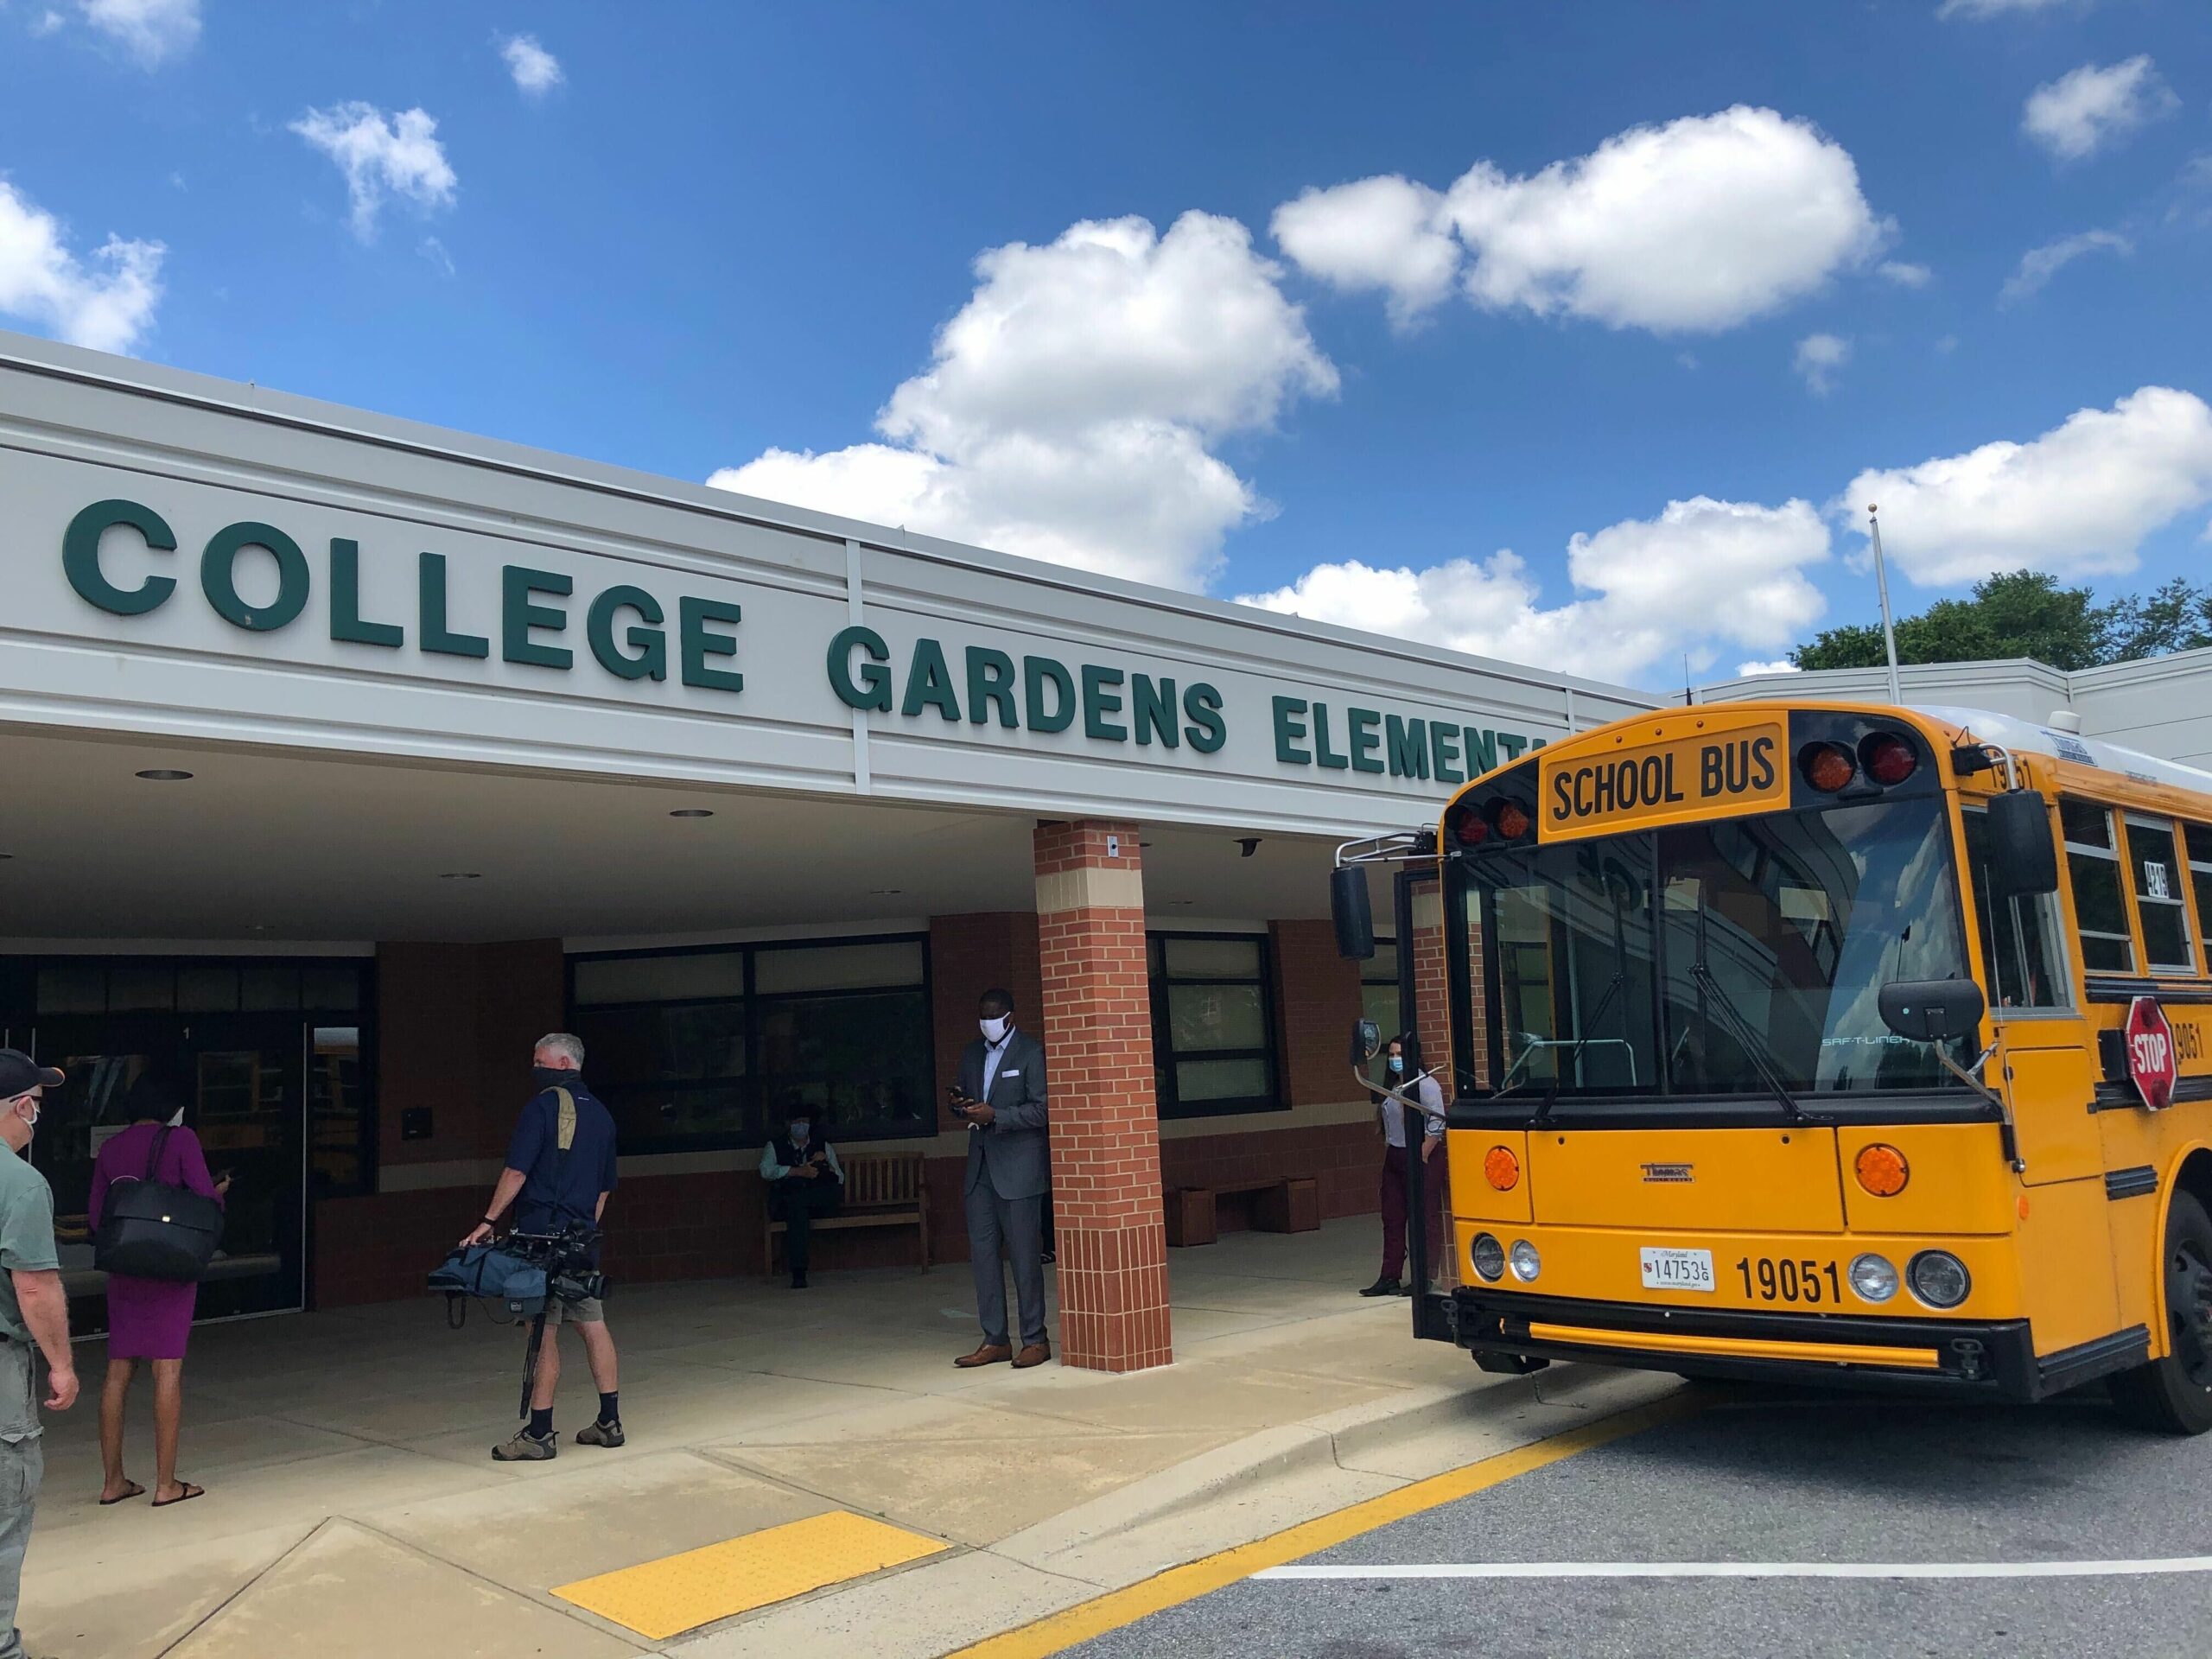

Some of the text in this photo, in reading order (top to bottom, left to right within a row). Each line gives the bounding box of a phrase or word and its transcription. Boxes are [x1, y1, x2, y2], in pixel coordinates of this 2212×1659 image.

[62, 499, 1547, 784] COLLEGE GARDENS ELEMENT
[1553, 736, 1775, 821] SCHOOL BUS
[1986, 750, 2033, 790] 1951
[2133, 1033, 2167, 1074] STOP
[2174, 1023, 2204, 1065] 9051
[1655, 1260, 1700, 1281] 14753
[1736, 1257, 1840, 1304] 19051
